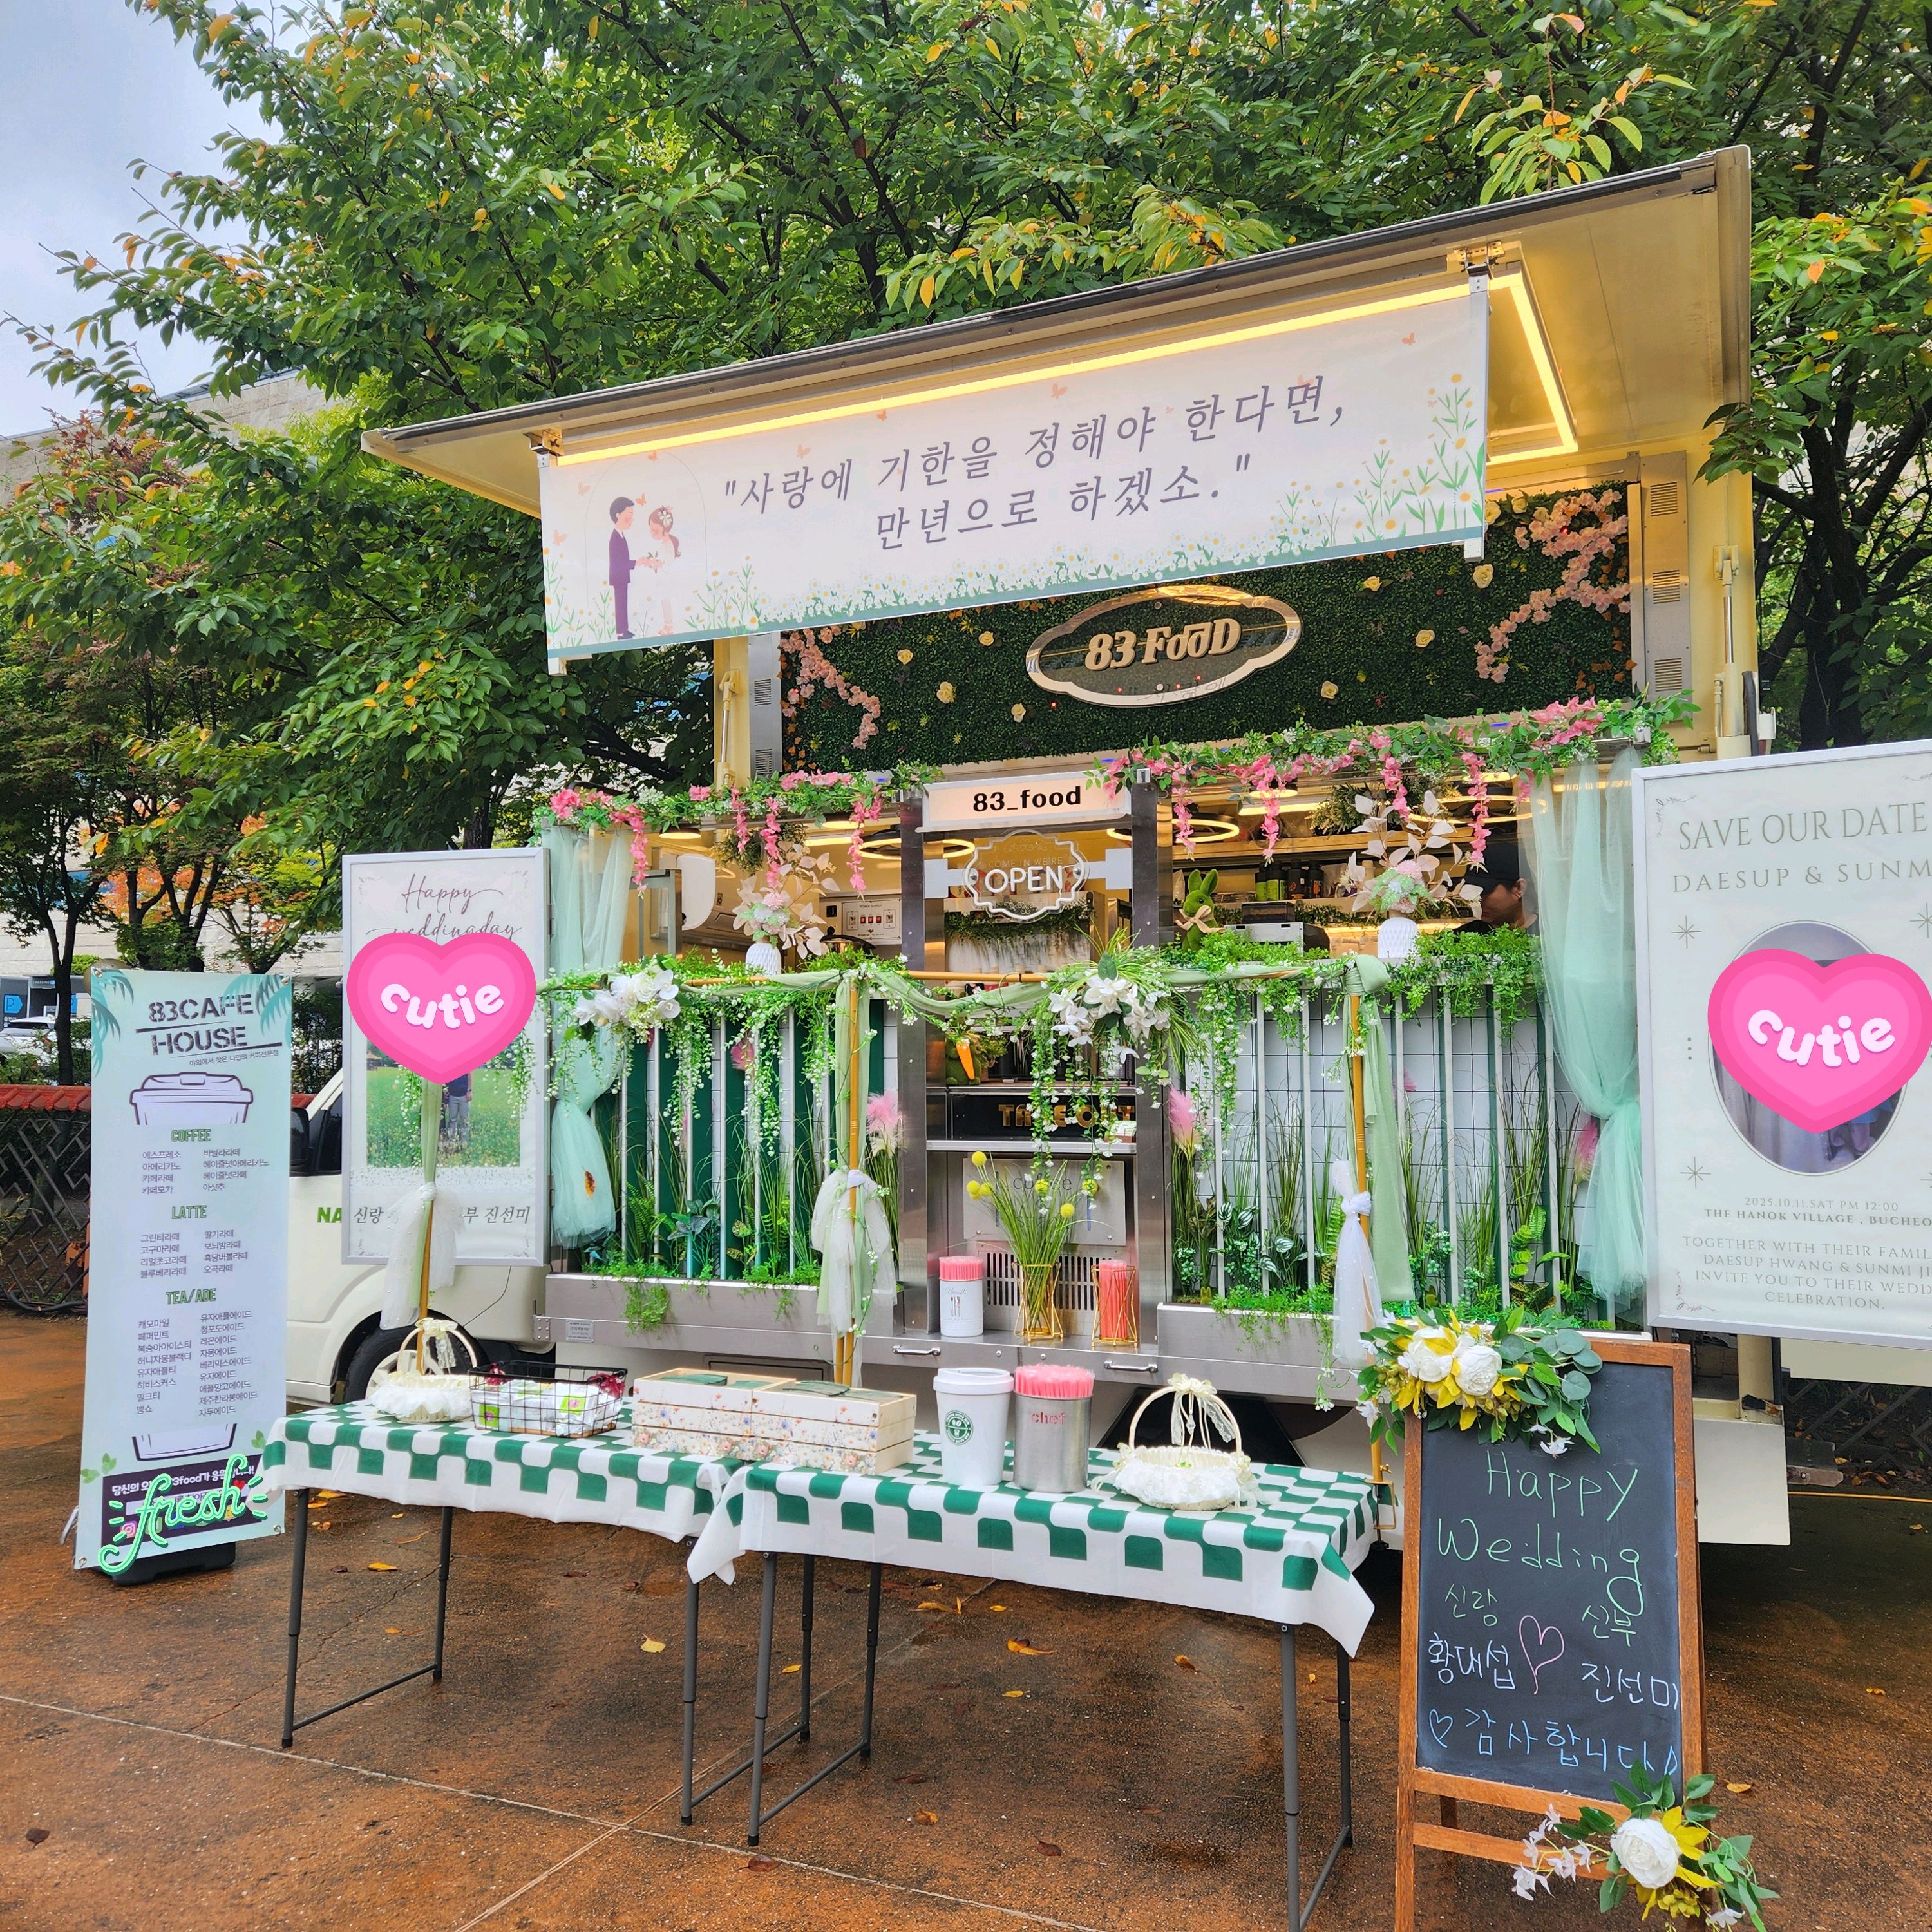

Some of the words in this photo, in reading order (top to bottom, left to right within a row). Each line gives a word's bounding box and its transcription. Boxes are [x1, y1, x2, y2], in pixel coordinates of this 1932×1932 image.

[725, 458, 853, 515] "사랑에
[877, 436, 998, 492] 기한을
[1025, 406, 1157, 468] 정해야
[1185, 375, 1343, 442] 한다면,
[877, 489, 1038, 551] 만년으로
[1084, 630, 1137, 671] 83
[972, 786, 1082, 812] 83_food
[1680, 817, 1752, 850] SAVE
[1762, 810, 1832, 844] OUR
[1841, 802, 1927, 838] DATE
[989, 860, 1016, 868] COME
[985, 865, 1063, 893] OPEN
[1674, 868, 1789, 893] DAESUP
[1805, 866, 1824, 884] &
[401, 873, 504, 914] Happy
[366, 911, 522, 944] eddinday
[148, 993, 254, 1023] 83CAFE
[151, 1025, 248, 1056] HOUSE
[229, 1053, 247, 1061] 나만의
[249, 1050, 279, 1058] 커피전문점
[998, 1104, 1066, 1127] TAE
[171, 1129, 211, 1142] COFFEE
[142, 1150, 182, 1159] 에스프레소
[204, 1148, 240, 1157] 바닐라라떼
[142, 1162, 182, 1171] 아메리카노
[142, 1174, 173, 1182] 카페라떼
[1014, 1173, 1072, 1190] coee
[142, 1186, 173, 1195] 카페모카
[203, 1182, 225, 1191] 아샷추
[1745, 1197, 1834, 1209] 2025.10.11.SAT
[1840, 1200, 1859, 1210] PM
[1866, 1201, 1899, 1211] 12:00
[172, 1205, 207, 1220] LATTE
[354, 1206, 384, 1224] 신랑
[484, 1206, 531, 1224] 진선미
[1705, 1209, 1731, 1218] THE
[1737, 1210, 1787, 1221] HANOK
[1793, 1213, 1854, 1224] VILLAGE
[140, 1233, 180, 1242] 그린티라떼
[204, 1229, 234, 1239] 딸기라떼
[140, 1244, 179, 1254] 고구마라떼
[1683, 1236, 1766, 1251] TOGETHER
[1772, 1241, 1815, 1254] WITH
[1822, 1244, 1871, 1256] THEIR
[140, 1255, 187, 1266] 리얼초코라떼
[204, 1251, 248, 1262] 흑당버블라떼
[204, 1264, 233, 1273] 오곡라떼
[1704, 1254, 1763, 1267] DAESUP
[1770, 1258, 1833, 1272] HWANG
[1839, 1262, 1850, 1272] &
[1855, 1262, 1911, 1276] SUNMI
[140, 1267, 187, 1278] 블루베리라떼
[1696, 1269, 1748, 1283] INVITE
[1754, 1274, 1788, 1286] YOU
[1795, 1276, 1817, 1288] TO
[1824, 1278, 1873, 1292] THEIR
[166, 1288, 216, 1305] TEA/ADE
[1765, 1292, 1885, 1309] CELEBRATION.
[200, 1310, 252, 1322] 유자애플에이드
[138, 1318, 169, 1329] 캐모마일
[200, 1323, 245, 1334] 청포도에이드
[138, 1331, 169, 1341] 페퍼민트
[200, 1335, 237, 1345] 레몬에이드
[137, 1340, 191, 1353] 복숭아아이스티
[200, 1347, 237, 1358] 자몽에이드
[137, 1352, 191, 1365] 허니자몽블랙티
[200, 1357, 251, 1369] 베리믹스에이드
[137, 1365, 176, 1378] 유자애플티
[200, 1370, 236, 1381] 유자에이드
[137, 1378, 176, 1389] 히비스커스
[199, 1380, 251, 1393] 애플망고에이드
[137, 1391, 160, 1401] 밀크티
[198, 1391, 258, 1405] 제주한라봉에이드
[137, 1405, 152, 1414] 뱅쇼
[198, 1405, 236, 1417] 자두에이드
[1032, 1412, 1065, 1425] chef
[111, 1481, 139, 1496] 당신의
[170, 1473, 211, 1486] 3food가
[1486, 1450, 1638, 1522] Happy
[1438, 1517, 1645, 1616] Wedding
[1445, 1583, 1499, 1627] 신랑
[1581, 1604, 1637, 1647] 신부
[1428, 1631, 1517, 1690] 황대섭
[1581, 1663, 1679, 1710] 진선미
